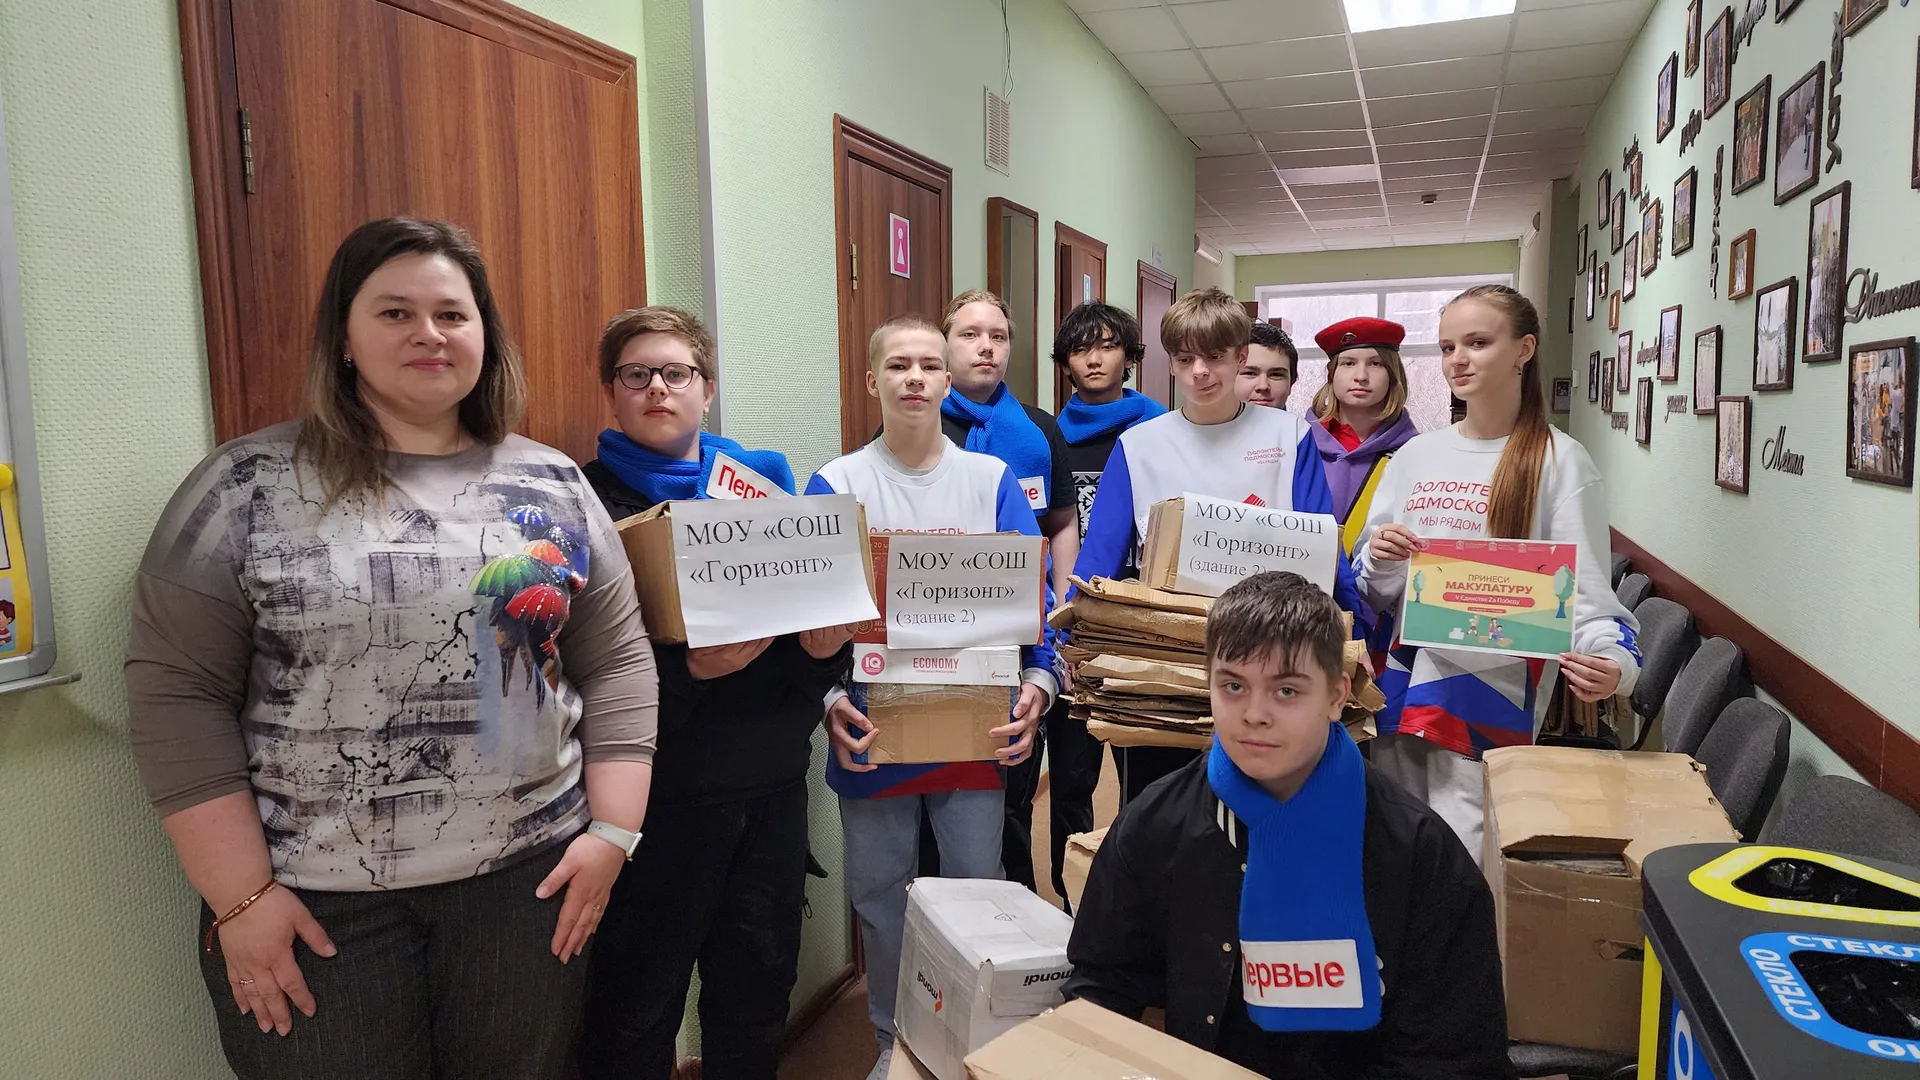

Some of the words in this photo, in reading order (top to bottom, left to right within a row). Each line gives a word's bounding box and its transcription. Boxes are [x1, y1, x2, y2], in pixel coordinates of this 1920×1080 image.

[1411, 481, 1491, 497] ВОЛОНТЕ
[1403, 496, 1489, 515] ОДМОСКО
[1194, 501, 1248, 523] МОУ
[1255, 512, 1323, 534] «СОШ
[1418, 516, 1439, 526] МЫ
[1439, 516, 1482, 532] РЯДОМ
[684, 519, 754, 546] МОУ
[763, 514, 842, 540] «СОШ
[1192, 530, 1310, 561] «Горизонт»
[897, 552, 954, 570] МОУ
[960, 551, 1027, 570] «СОШ
[1189, 555, 1247, 576] (здание
[690, 556, 833, 586] «Горизонт»
[1468, 574, 1510, 583] ПРИНЕСИ
[896, 581, 1015, 603] «Горизонт»
[1445, 580, 1533, 594] МАКУЛАТУРУ
[895, 609, 956, 627] (здание
[959, 608, 976, 626] 2)
[865, 656, 881, 668] IQ
[913, 657, 960, 669] ECONOMY
[1786, 935, 1920, 958] СТЕКЛ
[917, 971, 938, 1000] mondi
[1023, 970, 1074, 987] mondi
[1750, 948, 1821, 1021] СТЕКЛО
